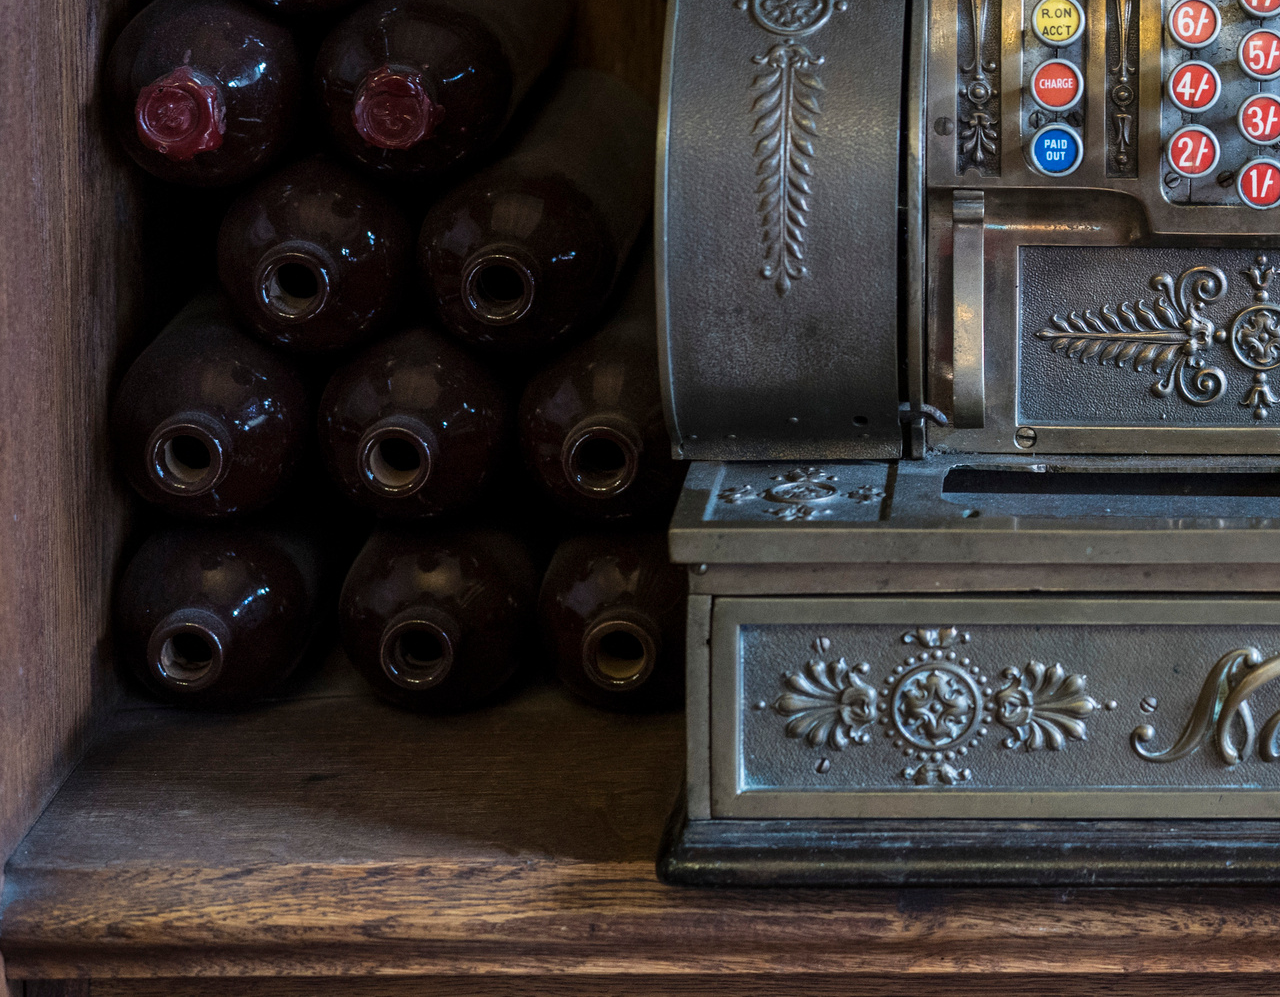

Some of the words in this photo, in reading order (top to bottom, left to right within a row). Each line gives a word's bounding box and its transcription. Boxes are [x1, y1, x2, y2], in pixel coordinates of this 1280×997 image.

[1039, 79, 1073, 89] CHARGE
[1044, 139, 1068, 149] PAID
[1046, 151, 1065, 161] OUT
